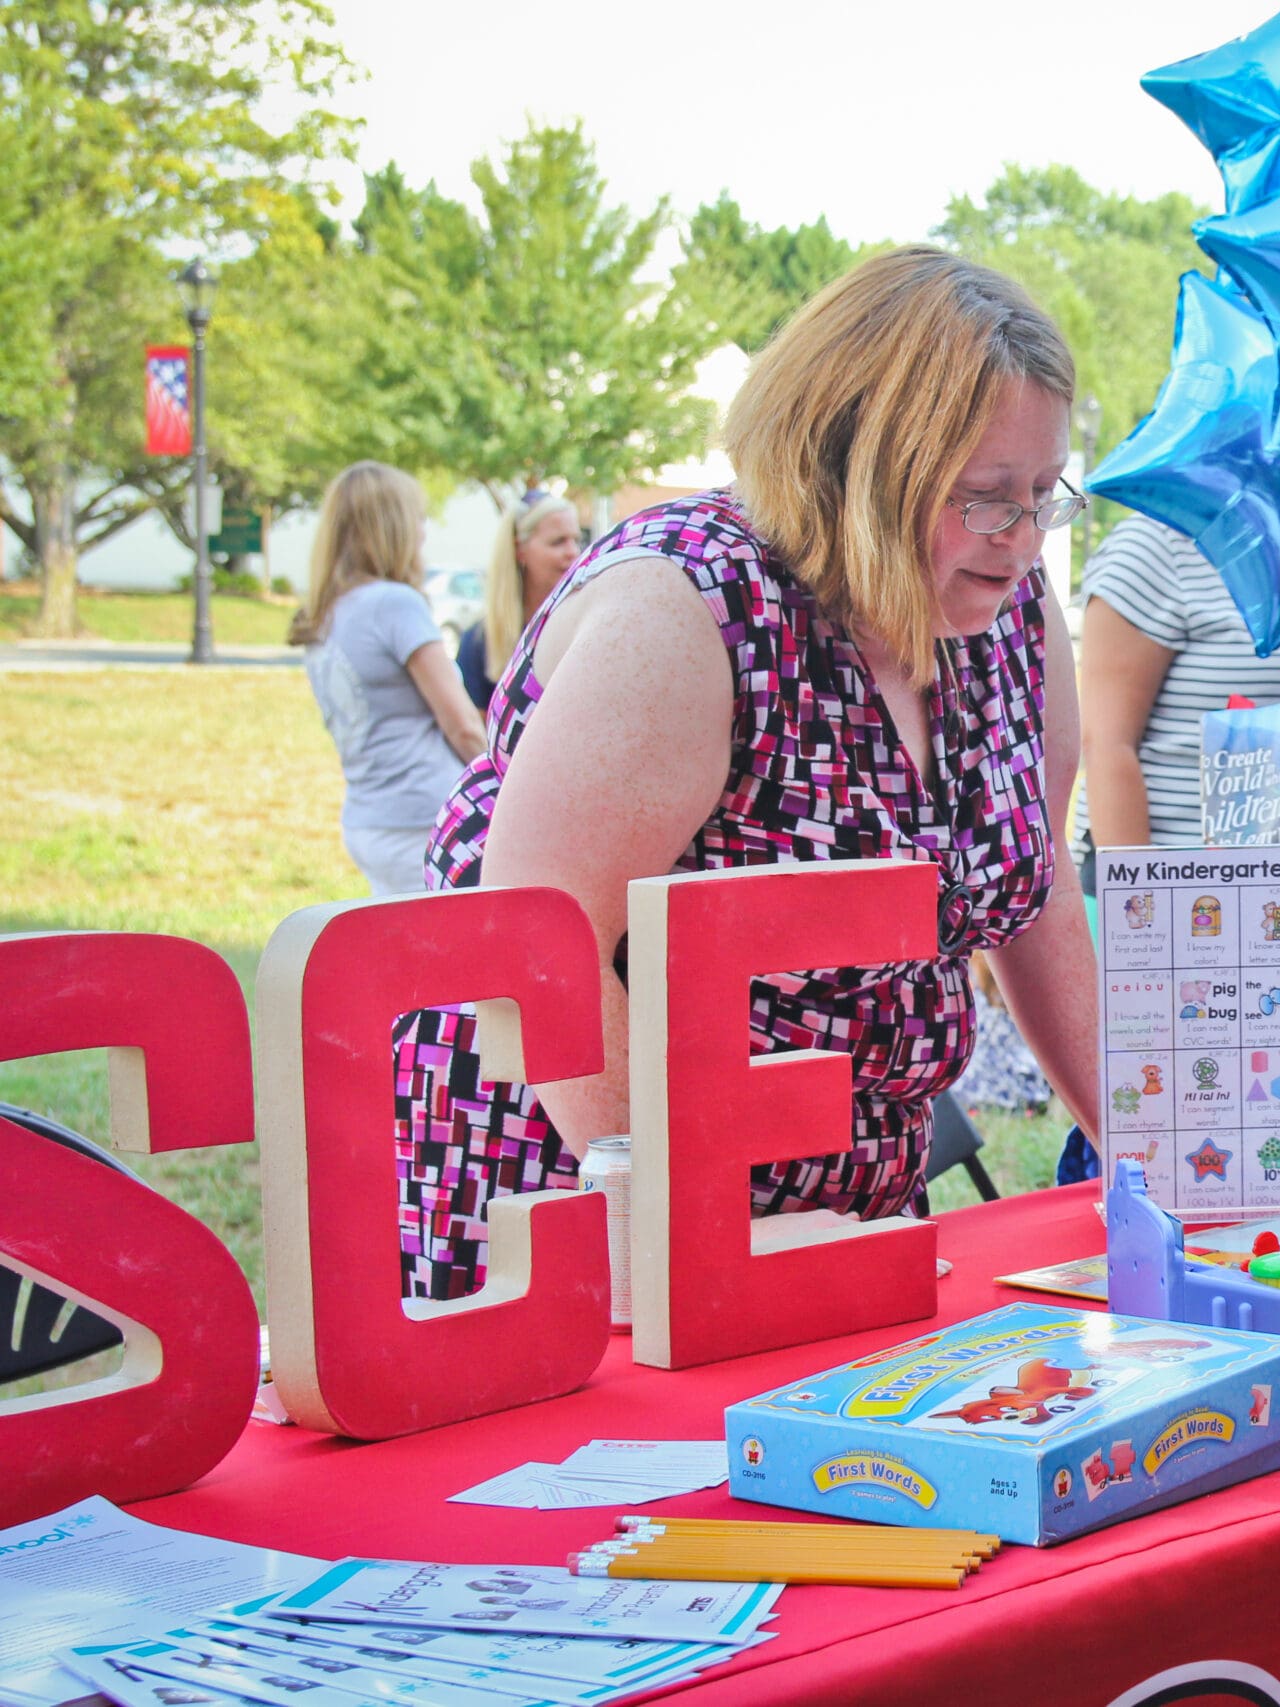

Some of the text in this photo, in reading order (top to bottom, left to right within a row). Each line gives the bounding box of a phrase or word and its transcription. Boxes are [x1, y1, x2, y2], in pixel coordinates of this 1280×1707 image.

[1214, 748, 1273, 769] Create
[1107, 863, 1140, 885] My
[1155, 933, 1166, 941] my
[1115, 944, 1163, 953] first and last
[1192, 943, 1214, 951] know
[1215, 944, 1225, 952] my
[1254, 941, 1274, 950] know
[1213, 982, 1236, 997] pig
[1246, 981, 1261, 989] the
[1120, 1012, 1139, 1020] know
[1142, 1011, 1151, 1019] all
[1153, 1011, 1165, 1019] the
[1208, 1007, 1237, 1021] bug
[1109, 1025, 1170, 1035] vowels and their
[1183, 1038, 1205, 1046] CVC
[1259, 1036, 1276, 1047] sight
[1204, 1105, 1234, 1115] segment
[1199, 1155, 1220, 1166] 100
[1205, 1185, 1225, 1193] count
[861, 1363, 950, 1402] First
[935, 1324, 1080, 1362] Words
[1154, 1418, 1224, 1459] First Words
[828, 1462, 921, 1495] First Words
[991, 1478, 1010, 1488] Ages
[1007, 1489, 1018, 1498] Up
